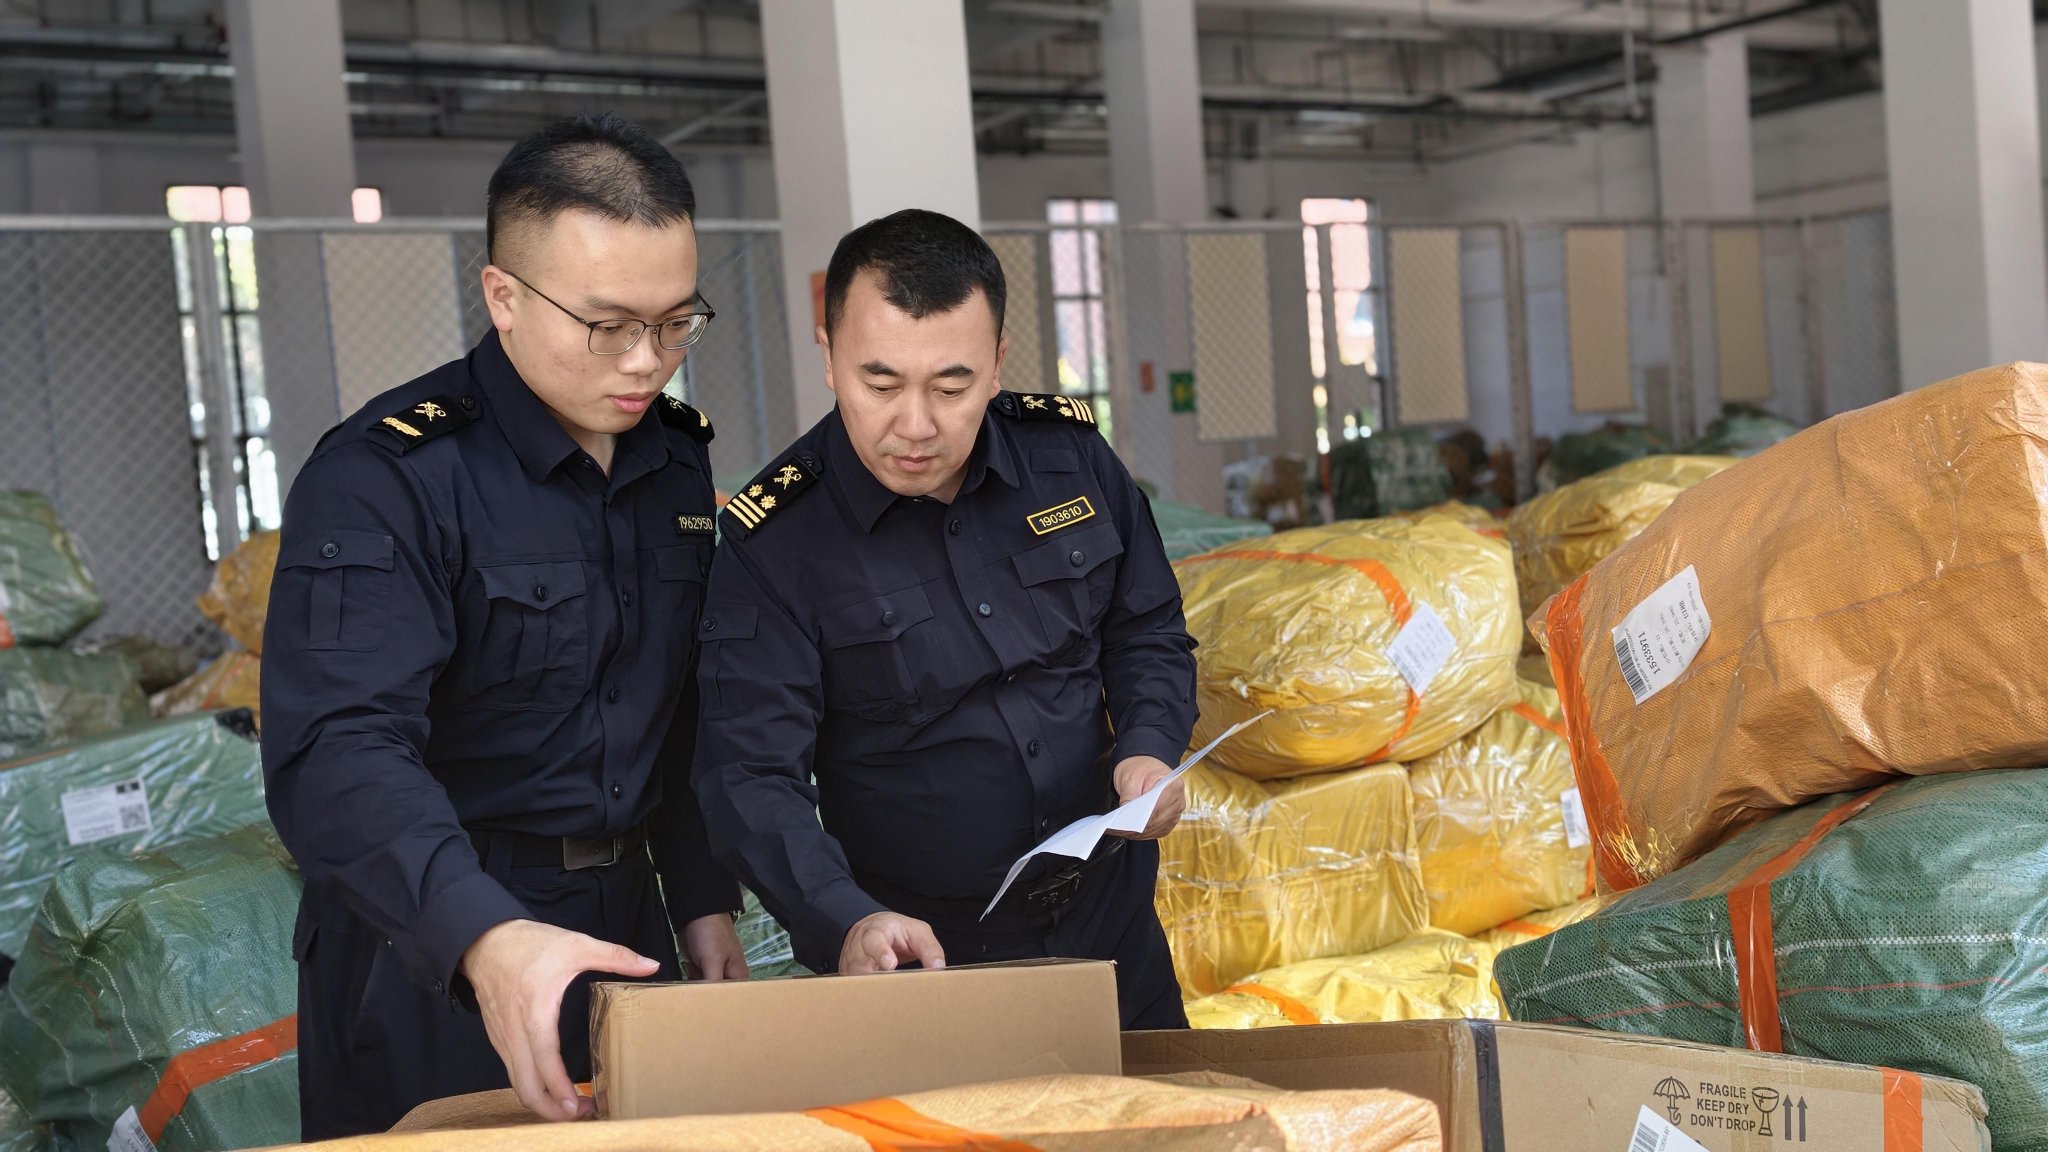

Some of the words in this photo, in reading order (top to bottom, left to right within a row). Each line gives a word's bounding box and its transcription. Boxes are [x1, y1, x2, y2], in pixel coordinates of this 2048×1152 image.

[678, 516, 714, 530] 1962950
[1038, 505, 1082, 527] 1903610
[1637, 631, 1662, 675] 1533971
[1699, 1082, 1747, 1099] FRAGILE
[1697, 1098, 1725, 1112] KEEP
[1728, 1101, 1750, 1116] DRY
[1690, 1113, 1724, 1129] DON'T
[1726, 1117, 1756, 1132] DROP
